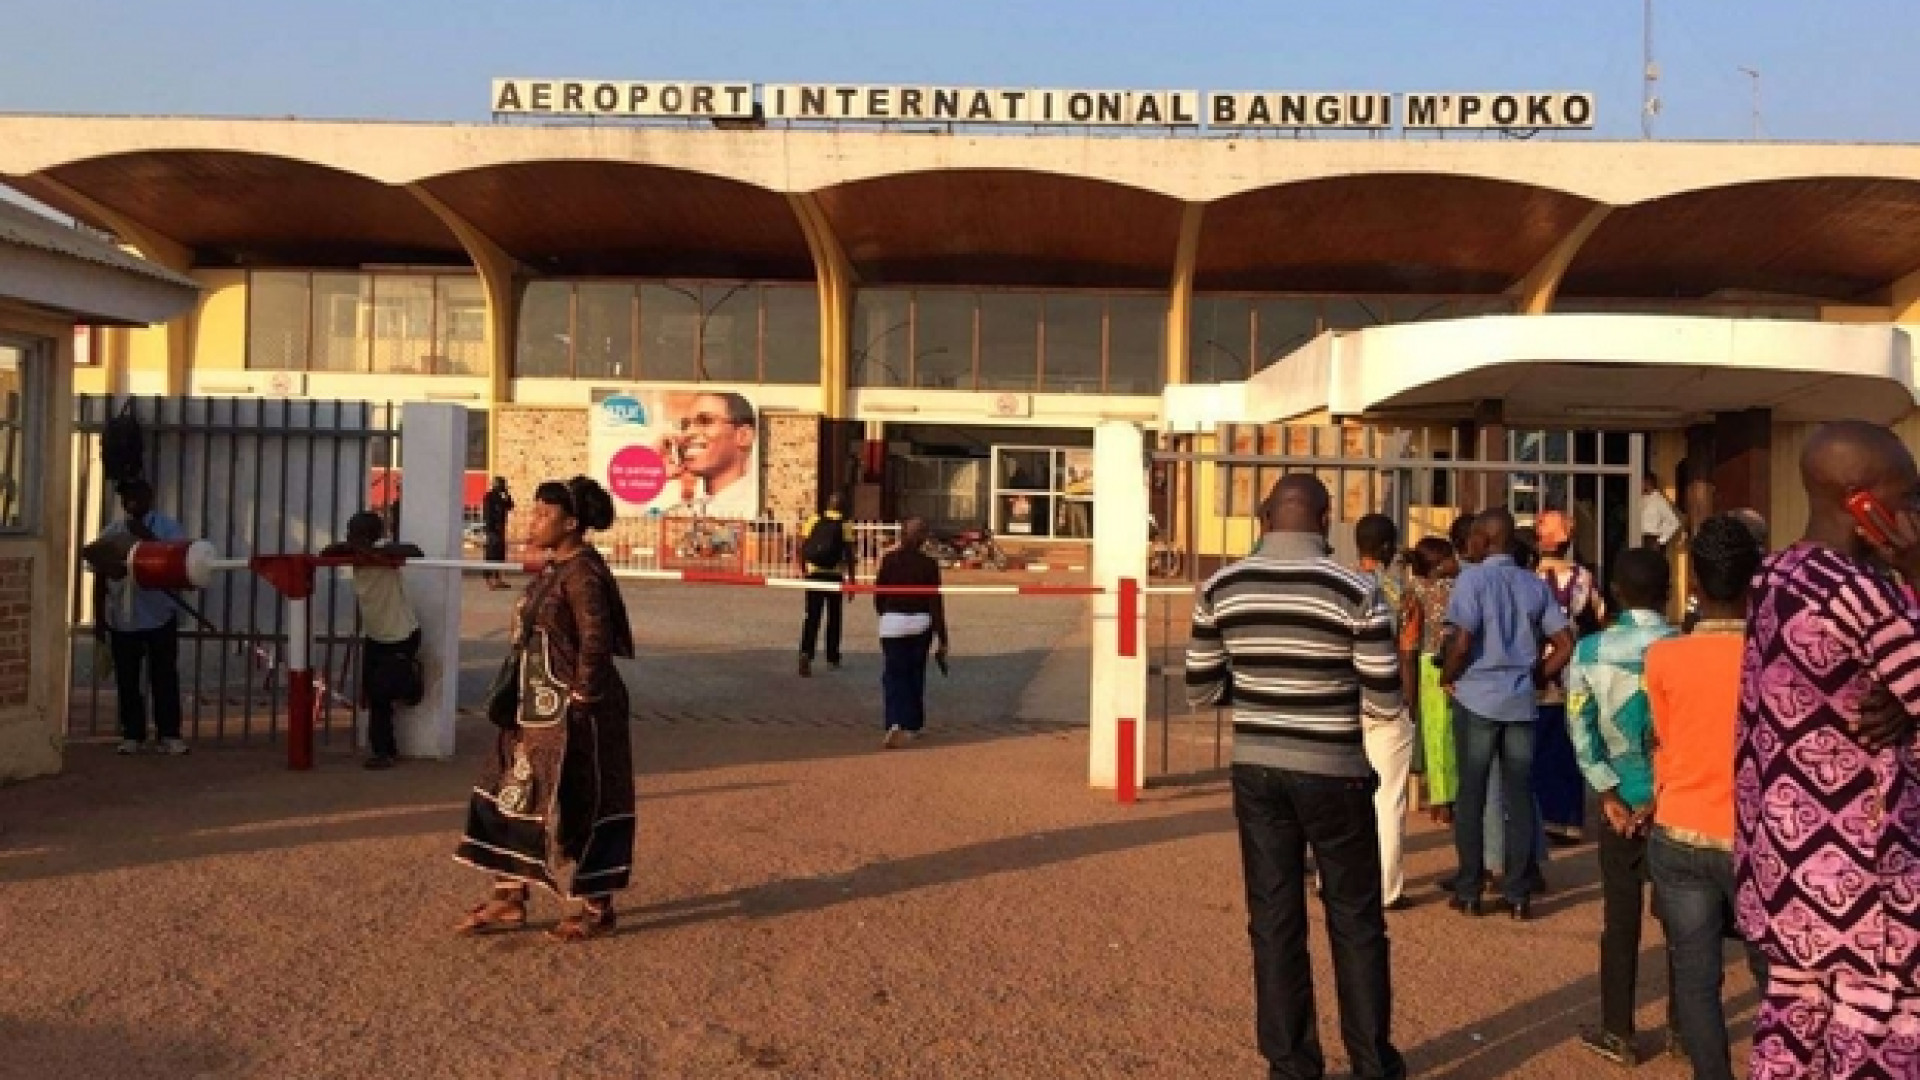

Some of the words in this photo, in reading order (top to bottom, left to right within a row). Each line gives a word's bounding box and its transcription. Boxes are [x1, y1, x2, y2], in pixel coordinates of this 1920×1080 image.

[497, 82, 747, 112] AEROPORT
[776, 88, 1193, 121] INTERNATIONAL
[1213, 95, 1389, 124] BANGUI
[1408, 95, 1590, 125] M'POKO
